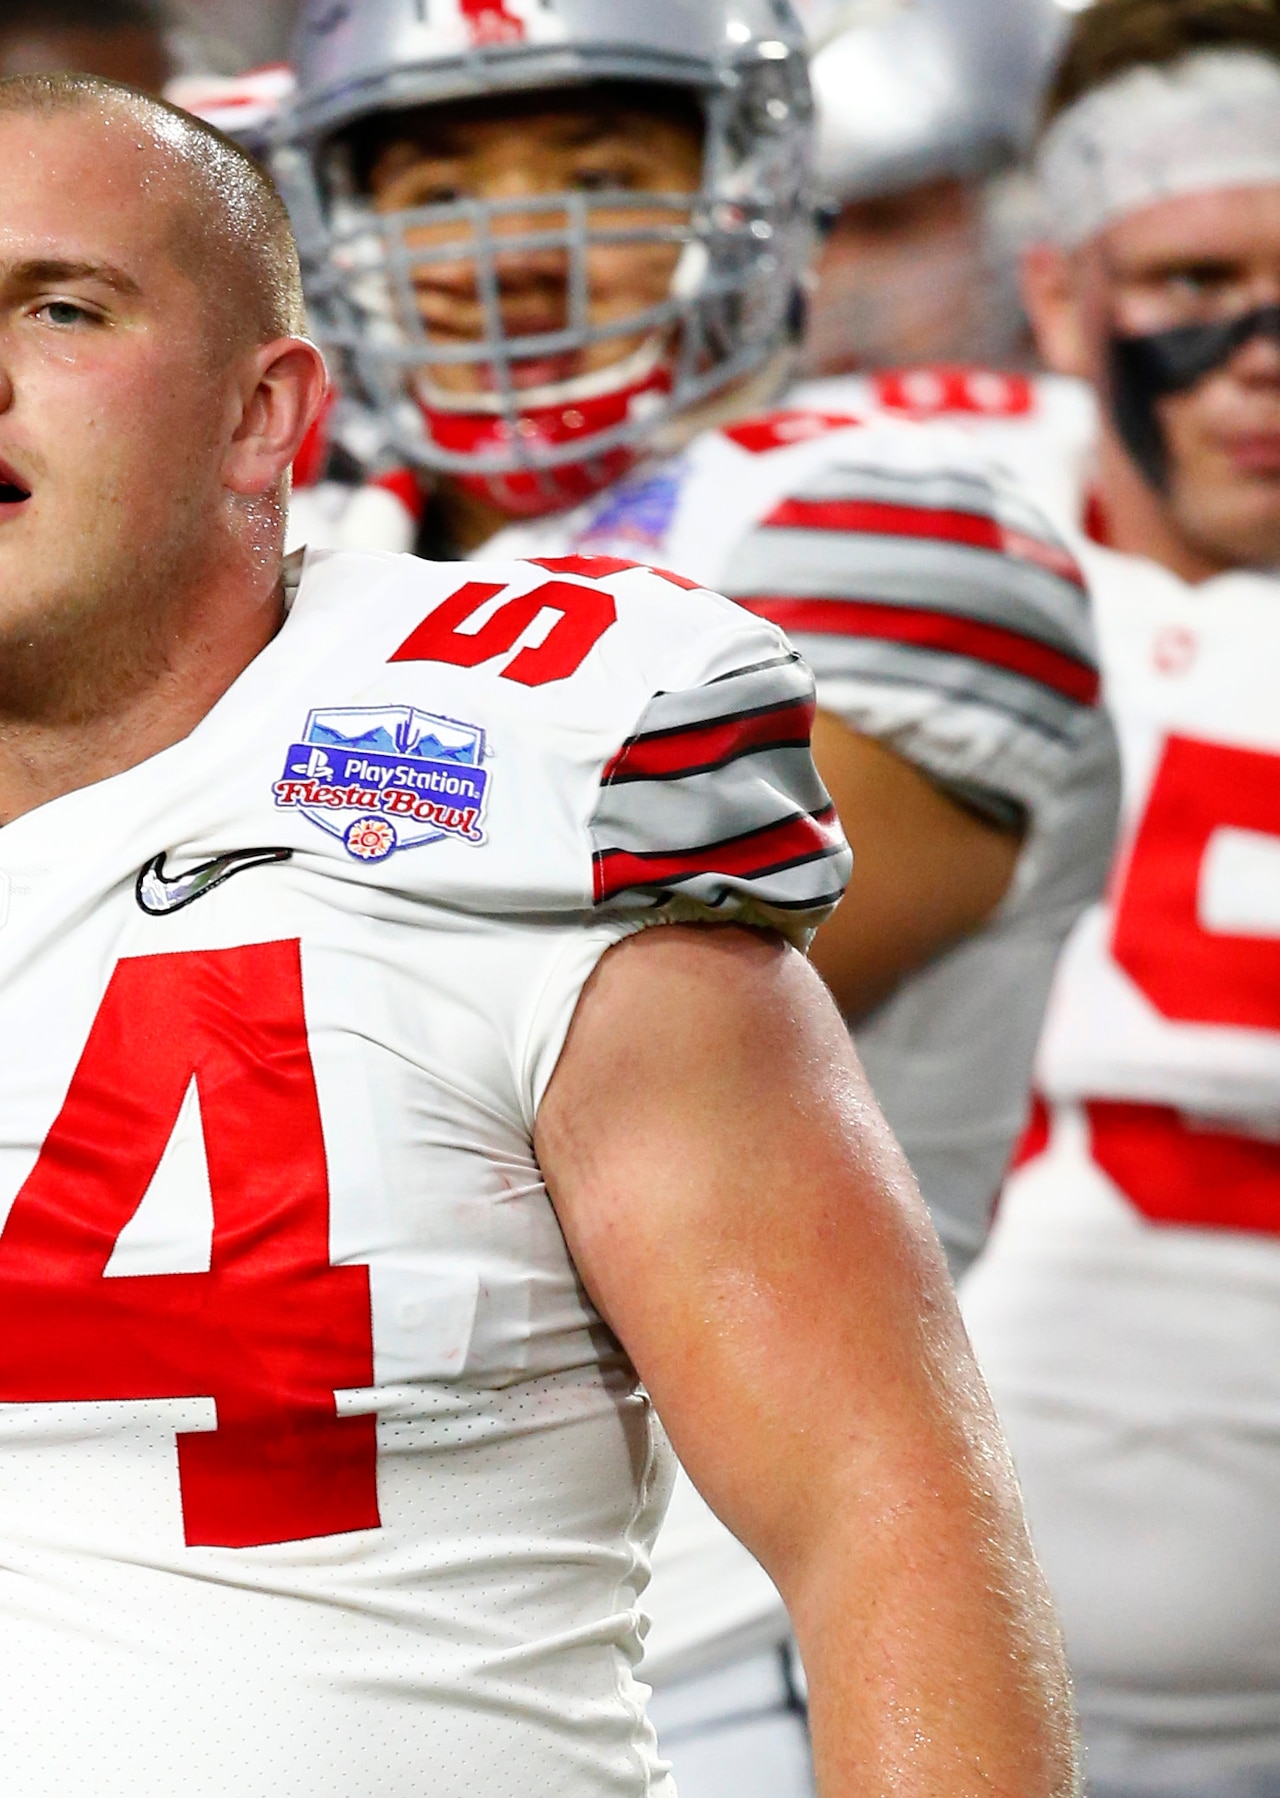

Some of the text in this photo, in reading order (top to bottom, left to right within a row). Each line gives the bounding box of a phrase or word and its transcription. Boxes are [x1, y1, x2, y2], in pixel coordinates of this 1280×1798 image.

[387, 555, 702, 687] 5
[344, 758, 476, 798] PlayStation
[276, 780, 477, 834] Fiesta Bowl
